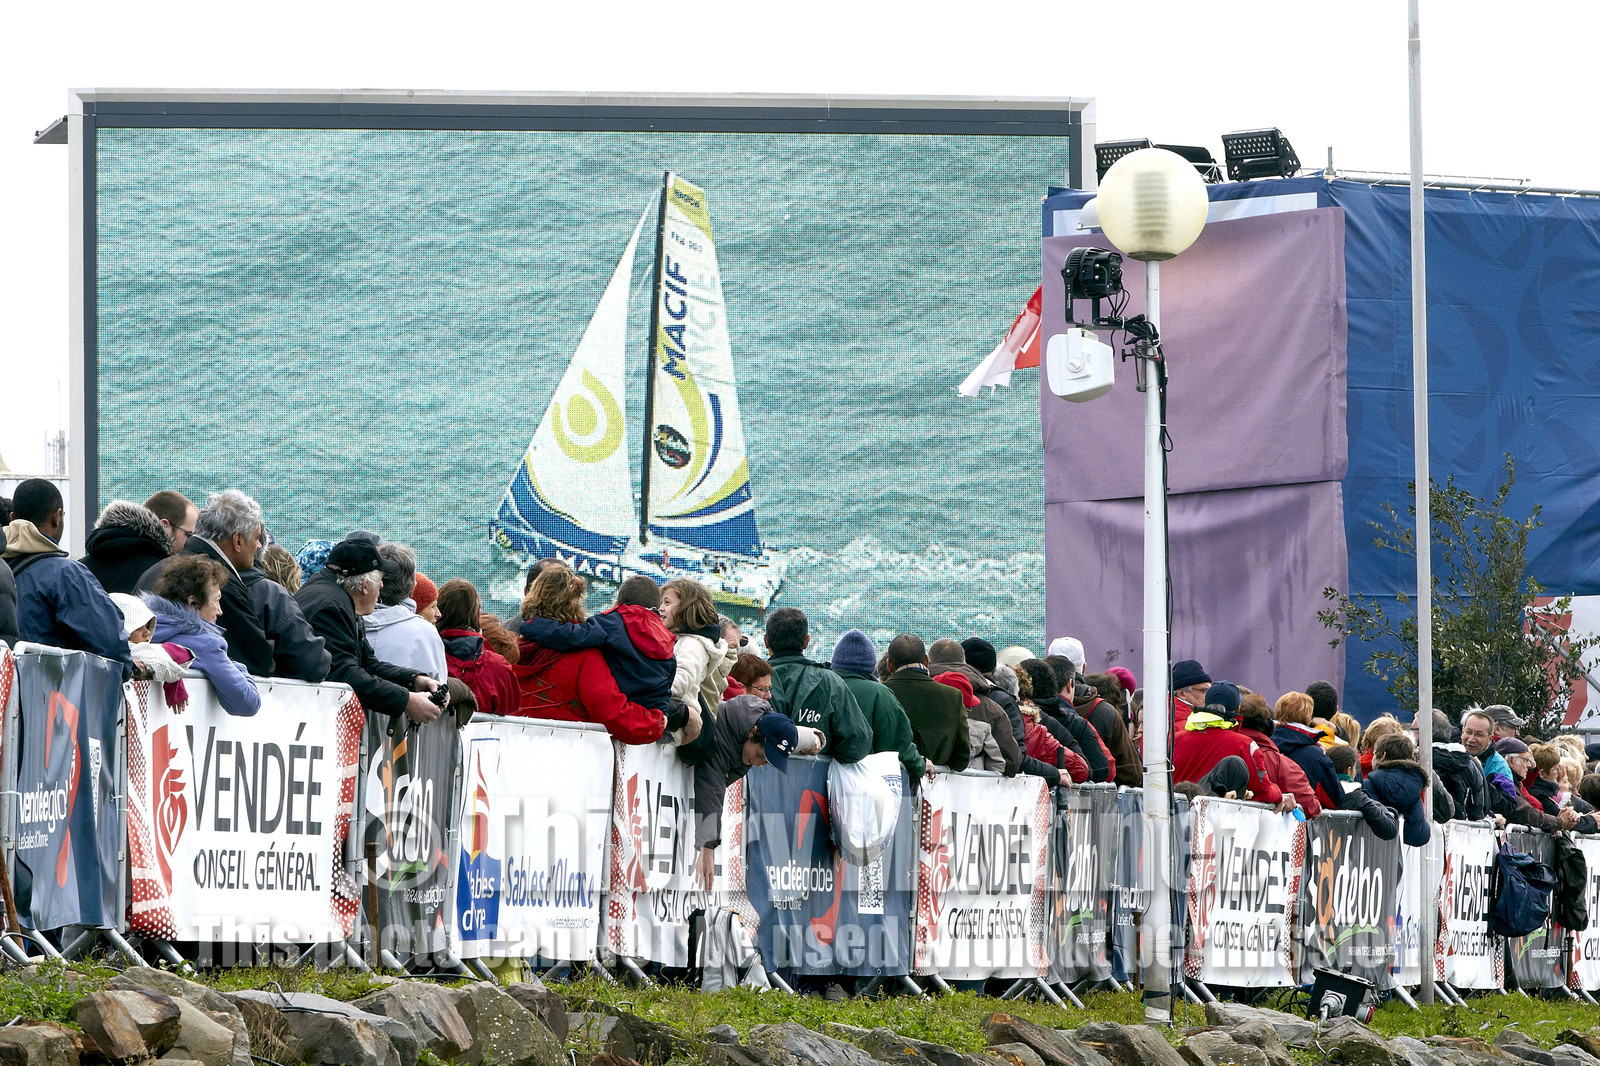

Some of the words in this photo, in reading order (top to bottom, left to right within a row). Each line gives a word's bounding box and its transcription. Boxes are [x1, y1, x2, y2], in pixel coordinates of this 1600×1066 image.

[662, 255, 687, 380] MACIF
[798, 708, 821, 723] Vélo
[186, 722, 324, 836] VENDÉE
[951, 806, 1033, 896] VENDÉE
